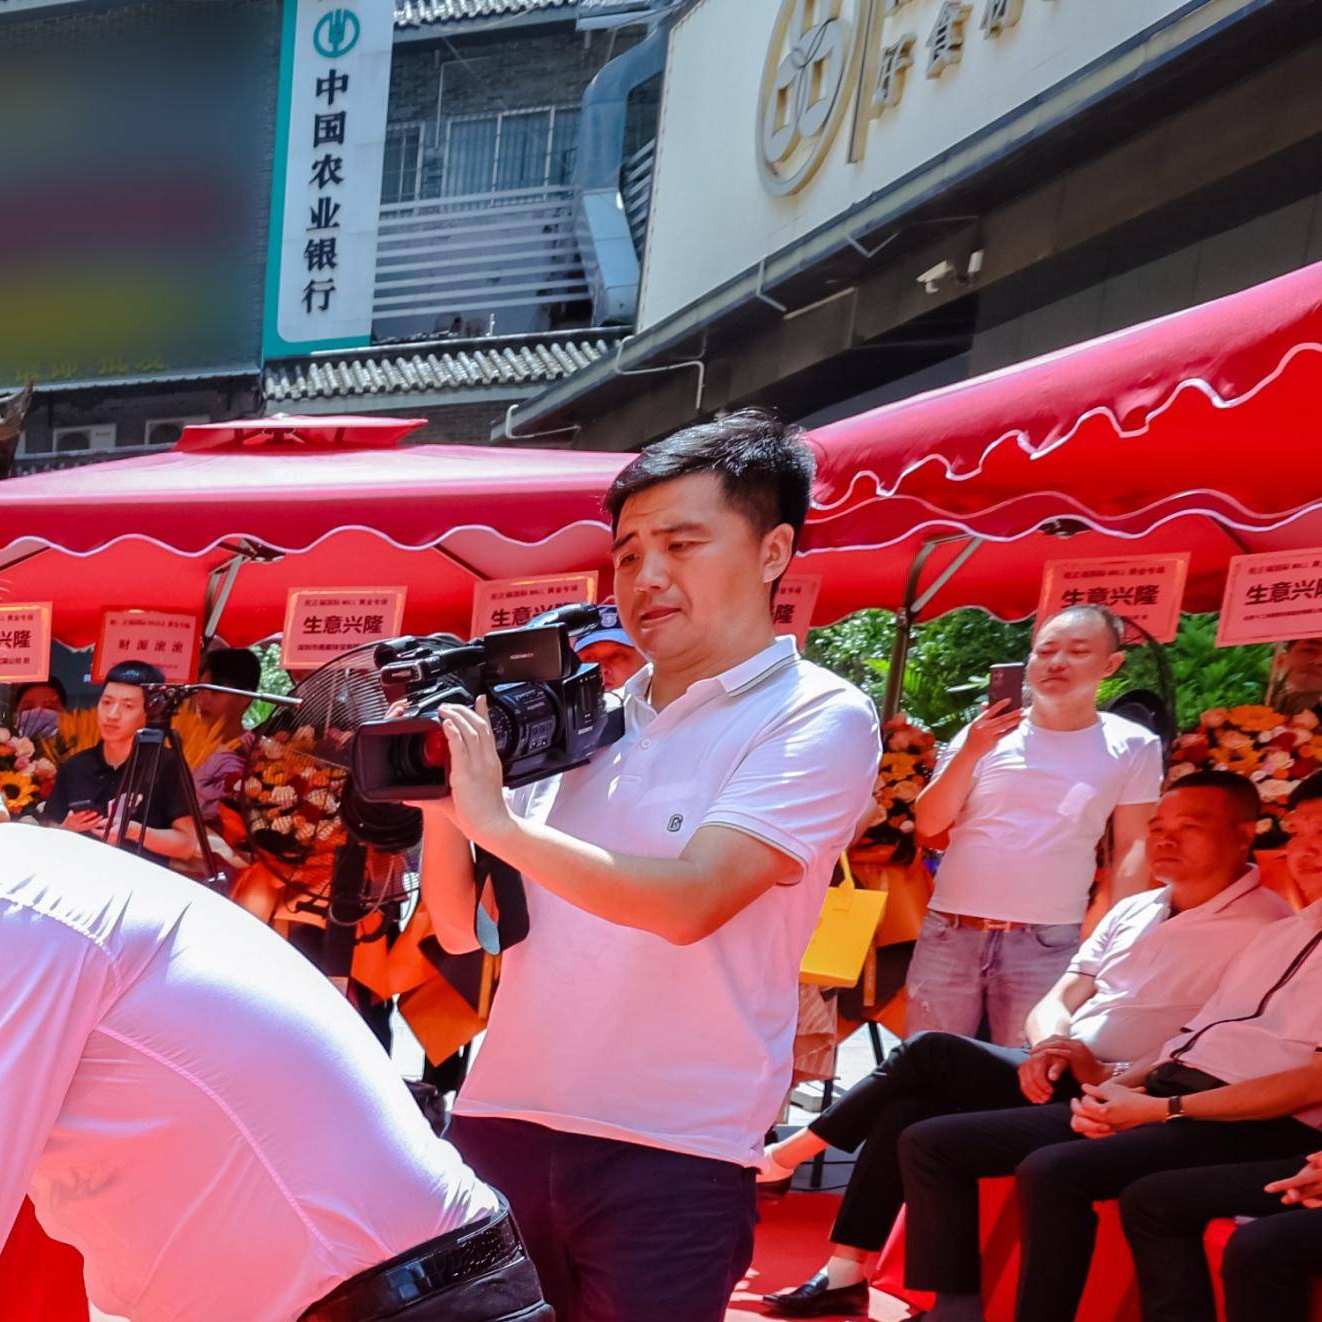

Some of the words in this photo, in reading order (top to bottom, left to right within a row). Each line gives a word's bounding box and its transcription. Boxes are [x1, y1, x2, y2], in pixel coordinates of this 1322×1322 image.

[301, 69, 350, 314] 中国农业银行
[302, 614, 384, 635] 生意兴隆
